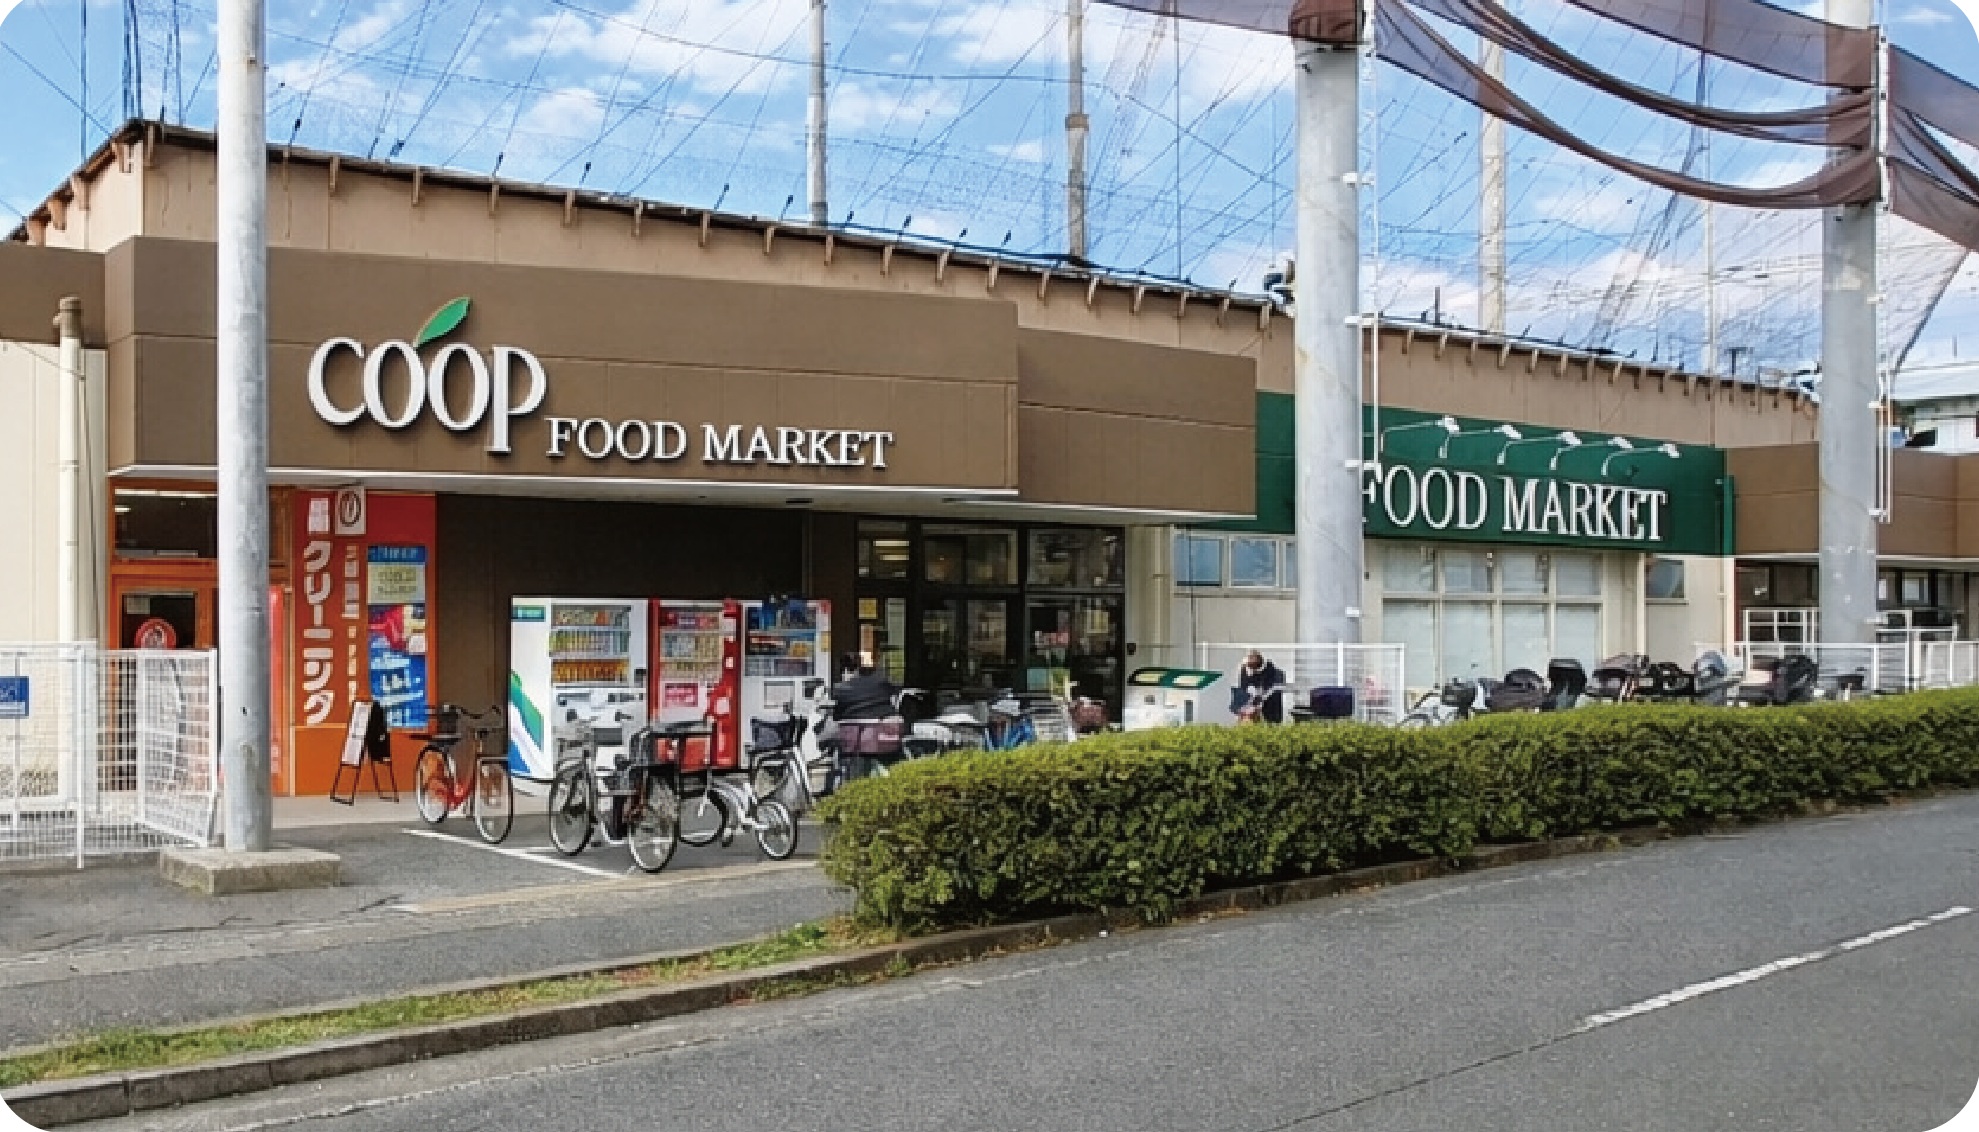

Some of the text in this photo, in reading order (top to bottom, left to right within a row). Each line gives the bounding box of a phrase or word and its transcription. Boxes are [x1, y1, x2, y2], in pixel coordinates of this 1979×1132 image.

[545, 417, 893, 468] FOOD MARKET
[1499, 474, 1669, 541] MARKET
